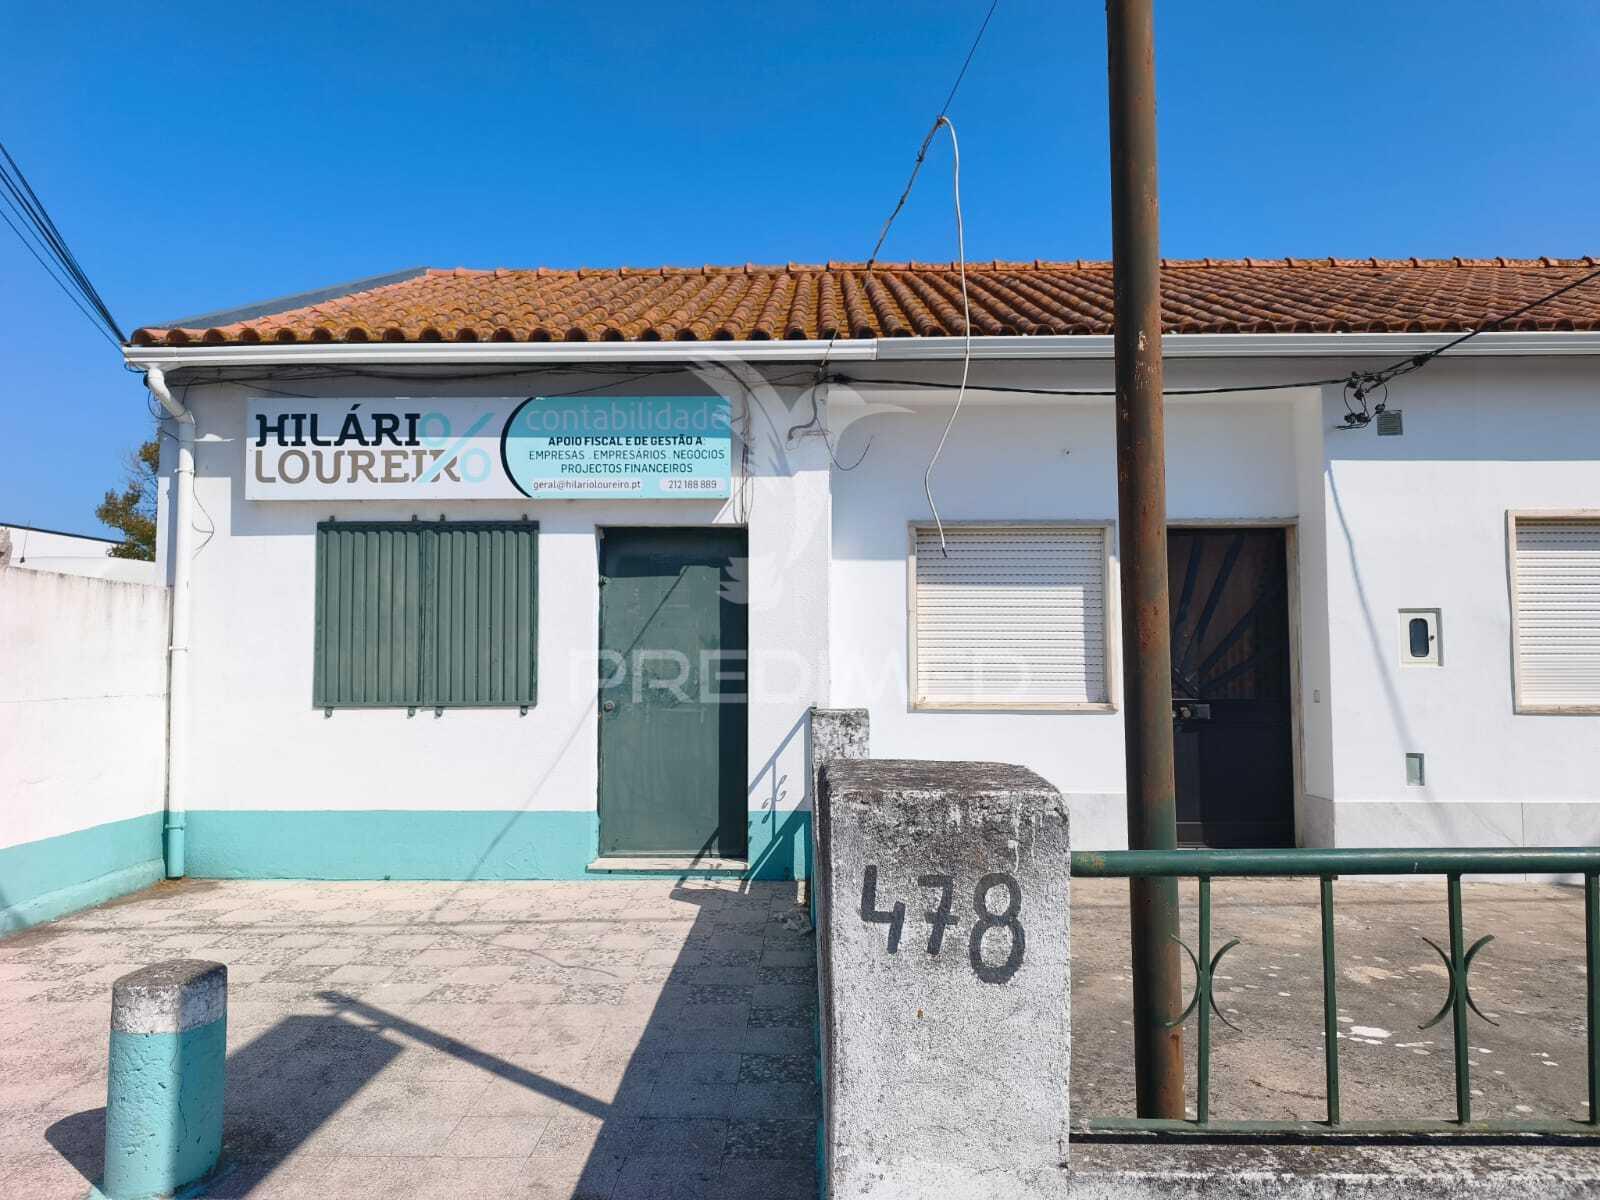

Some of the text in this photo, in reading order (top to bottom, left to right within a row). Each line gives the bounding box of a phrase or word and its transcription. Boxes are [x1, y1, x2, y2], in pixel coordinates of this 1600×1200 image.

[526, 401, 728, 432] contabilidade
[548, 436, 582, 446] APOIO
[584, 436, 623, 446] FISCAL
[625, 436, 633, 446] E
[634, 436, 649, 446] DE
[650, 433, 693, 446] GESTÃO
[529, 450, 585, 460] EMPRESAS
[561, 463, 693, 473] PROJECTOS FINANCEIROS
[533, 479, 641, 490] geral@hilarioloureiro.pt
[668, 479, 717, 489] 212 188 889
[861, 864, 1026, 985] 478
